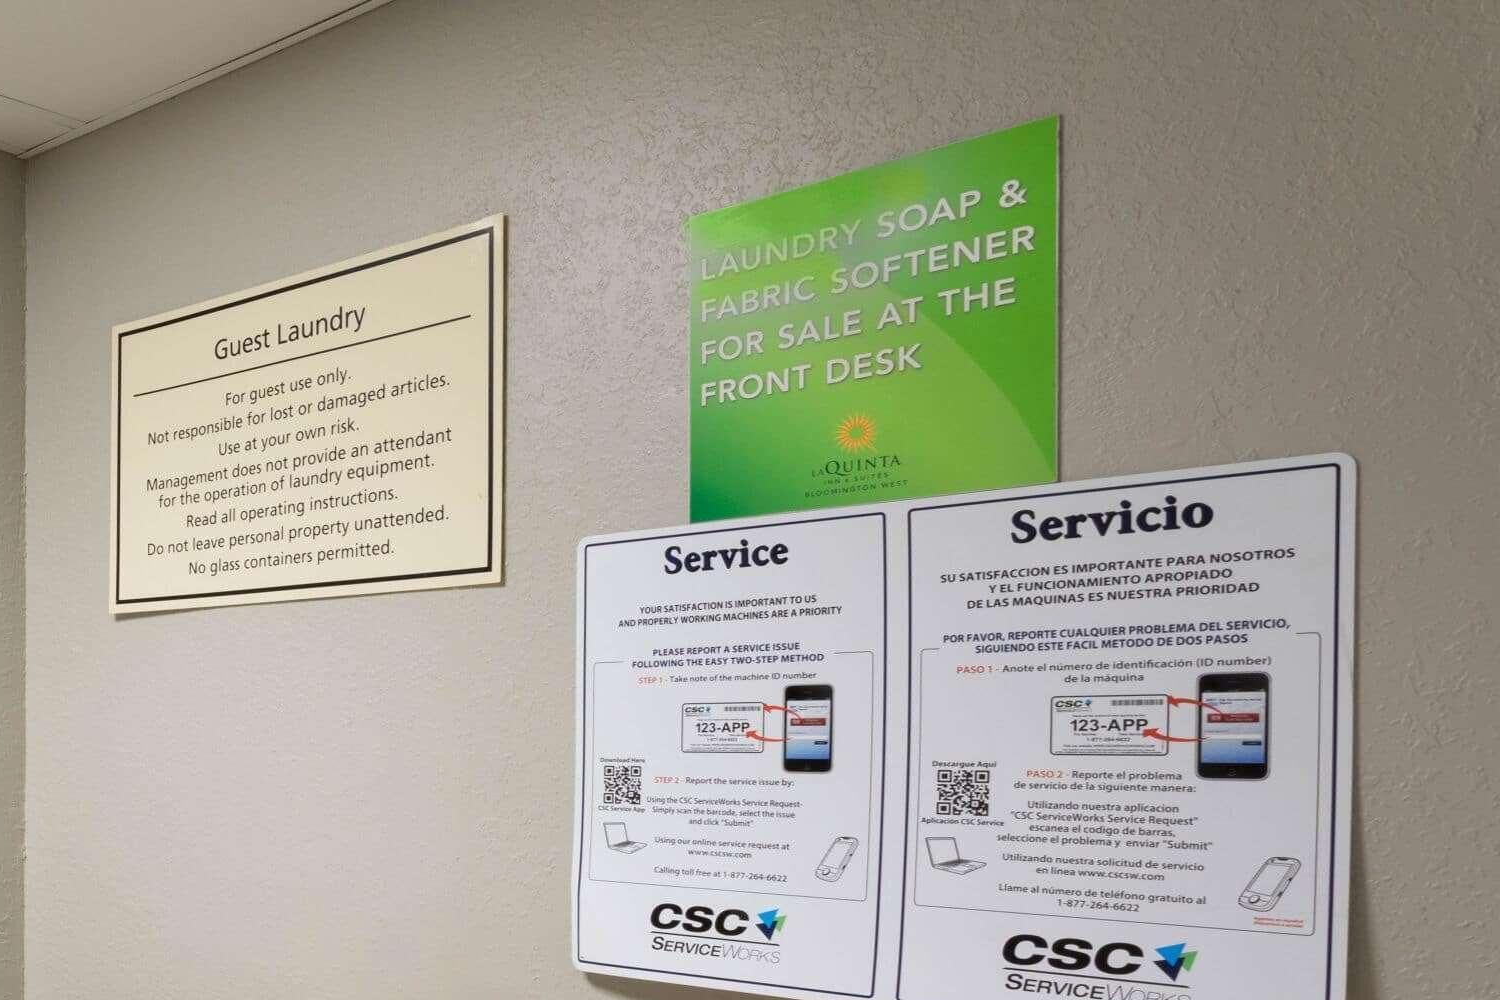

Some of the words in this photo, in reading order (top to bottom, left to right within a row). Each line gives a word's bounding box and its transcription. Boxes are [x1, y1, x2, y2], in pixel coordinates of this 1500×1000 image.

[701, 219, 860, 280] LAUNDRY
[877, 190, 980, 237] SOAP
[998, 180, 1027, 208] &
[701, 276, 814, 322] FABRIC
[830, 224, 1035, 293] SOFTENER
[214, 328, 270, 360] Guest
[277, 307, 365, 345] Laundry
[701, 330, 764, 364] FOR
[778, 309, 861, 348] SALE
[877, 295, 924, 330] AT
[937, 276, 1016, 315] THE
[225, 391, 246, 406] For
[249, 381, 285, 404] guest
[289, 376, 312, 392] use
[316, 369, 351, 386] only.
[700, 363, 811, 406] FRONT
[826, 342, 921, 384] DESK
[147, 430, 169, 445] Not
[173, 415, 243, 440] responsible
[246, 408, 266, 426] for
[270, 404, 295, 421] lost
[297, 402, 313, 415] or
[317, 385, 386, 412] damaged
[390, 374, 450, 397] articles.
[218, 442, 241, 456] Use
[244, 437, 257, 451] at
[260, 432, 291, 451] your
[295, 426, 326, 441] own
[330, 419, 359, 435] risk.
[146, 467, 228, 491] Management
[229, 463, 261, 478] does
[265, 456, 288, 472] not
[292, 446, 347, 471] provide
[350, 444, 368, 458] an
[373, 429, 452, 454] attendant
[158, 494, 177, 508] for
[179, 490, 200, 505] the
[203, 481, 266, 503] operation
[270, 475, 285, 491] of
[289, 469, 342, 488] laundry
[346, 455, 434, 481] equipment.
[186, 510, 217, 528] Read
[220, 507, 235, 523] all
[240, 501, 304, 522] operating
[309, 488, 398, 510] instructions.
[1010, 496, 1214, 544] Servicio
[147, 543, 164, 555] Do
[167, 539, 188, 554] not
[192, 537, 225, 550] leave
[229, 525, 284, 549] personal
[288, 520, 349, 542] property
[354, 505, 449, 531] unattended.
[188, 559, 206, 575] No
[209, 557, 240, 575] glass
[243, 551, 313, 569] containers
[316, 539, 394, 565] permitted.
[664, 539, 789, 575] Service
[939, 573, 956, 583] SU
[958, 566, 1050, 582] SATISFACCION
[1053, 564, 1068, 575] ES
[1071, 557, 1162, 573] IMPORTANTE
[1166, 554, 1206, 566] PARA
[1209, 547, 1295, 563] NOSOTROS
[966, 599, 983, 609] DE
[986, 597, 1009, 608] LAS
[1012, 593, 1084, 606] MAQUINAS
[1088, 591, 1104, 602] ES
[1106, 587, 1172, 600] NUESTRA
[1175, 582, 1260, 596] PRIORIDAD
[988, 584, 997, 593] Y
[999, 583, 1014, 593] EL
[1016, 574, 1141, 592] FUNCIONAMIENTO
[1144, 567, 1233, 583] APROPIADO
[618, 619, 636, 627] AND
[637, 616, 679, 626] PROPERLY
[680, 613, 721, 623] WORKING
[722, 610, 769, 621] MACHINES
[770, 608, 789, 618] ARE
[790, 608, 797, 617] A
[799, 605, 842, 616] PRIORITY
[639, 603, 662, 614] YOUR
[663, 601, 723, 613] SATISFACTION
[724, 600, 733, 608] IS
[734, 596, 788, 608] IMPORTANT
[788, 595, 802, 604] TO
[804, 594, 817, 603] US
[942, 633, 965, 643] POR
[966, 632, 1005, 642] FAVOR,
[1007, 629, 1058, 640] REPORTE
[1058, 626, 1126, 638] CUALQUIER
[1128, 622, 1196, 635] PROBLEMA
[1198, 621, 1223, 632] DEL
[1225, 618, 1291, 630] SERVICIO,
[974, 642, 1035, 654] SIGUIENDO
[1037, 641, 1064, 651] ESTE
[1066, 640, 1098, 649] FACIL
[1101, 637, 1154, 648] METODO
[1156, 636, 1173, 646] DE
[1175, 635, 1203, 645] DOS
[1205, 633, 1248, 644] PASOS
[631, 658, 684, 668] FOLLOWING
[685, 658, 703, 666] THE
[704, 656, 729, 665] EASY
[729, 655, 779, 664] TWO-STEP
[780, 653, 824, 663] METHOD
[652, 647, 684, 656] PLEASE
[686, 645, 721, 655] REPORT
[723, 645, 730, 653] A
[731, 643, 770, 653] SERVICE
[772, 642, 800, 651] ISSUE
[1054, 699, 1085, 708] CSC
[695, 722, 751, 733] 123-APP
[1069, 718, 1149, 732] 123-APP
[650, 903, 749, 936] CSC
[1002, 934, 1144, 975] CSC
